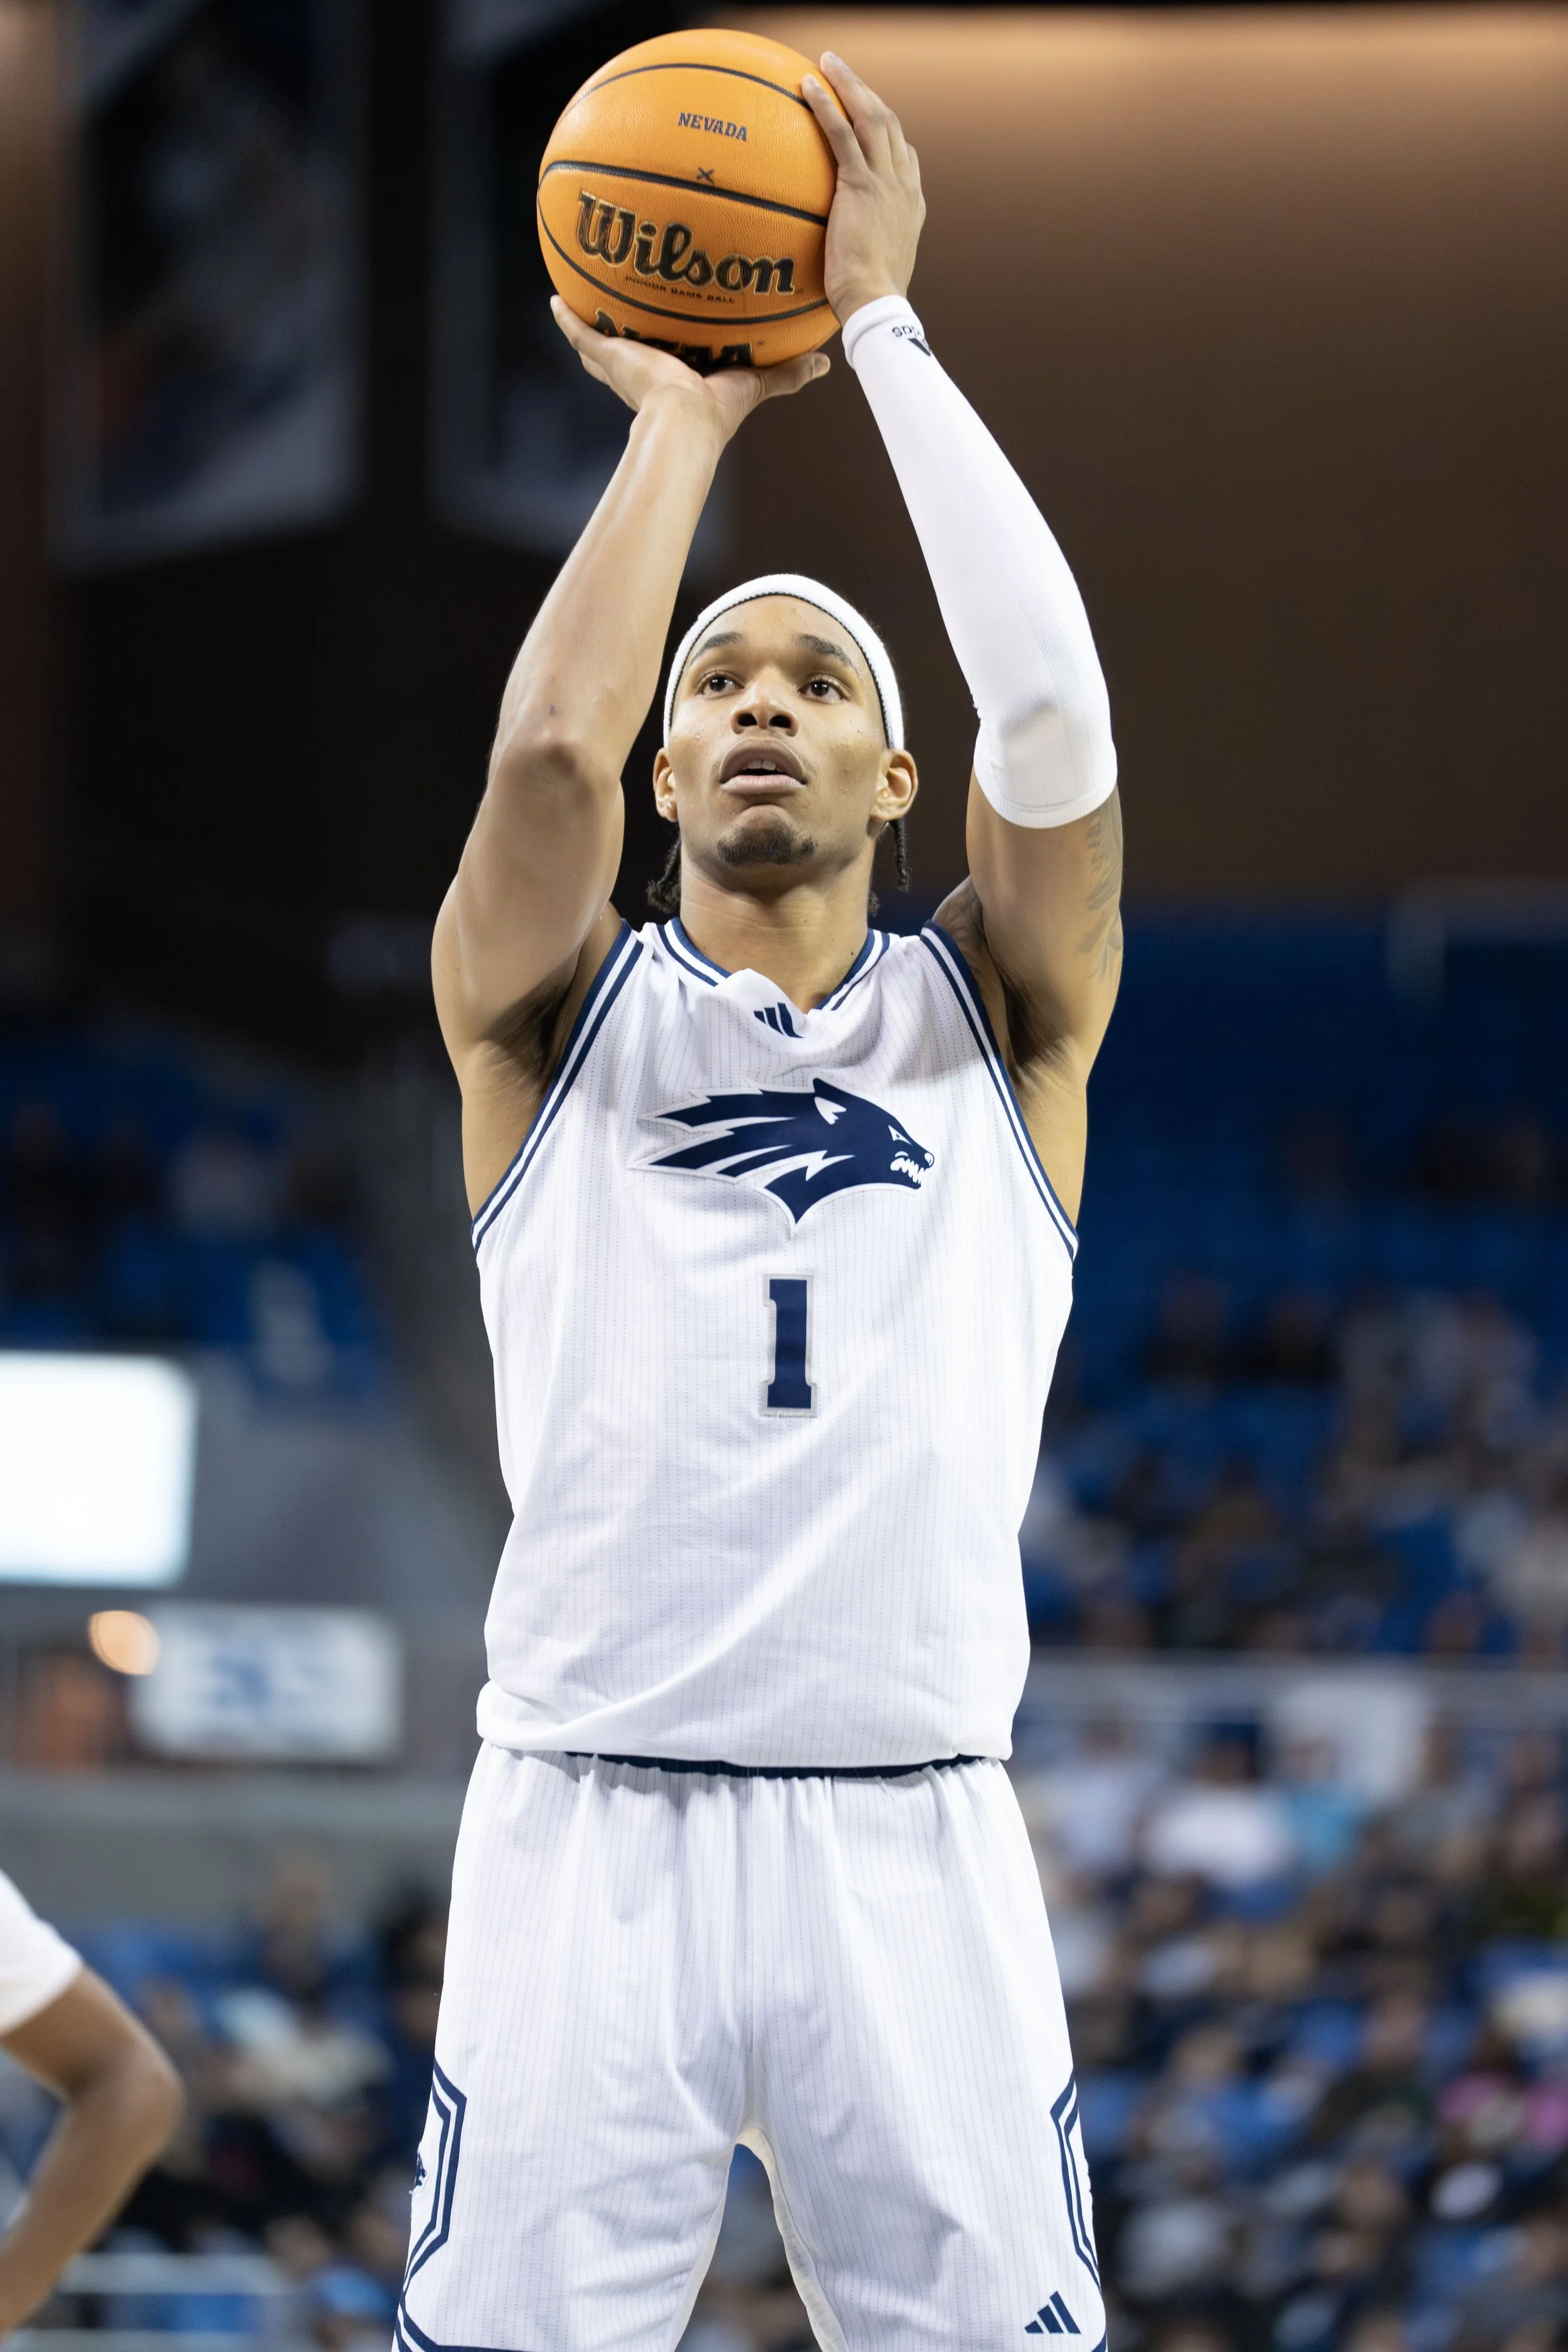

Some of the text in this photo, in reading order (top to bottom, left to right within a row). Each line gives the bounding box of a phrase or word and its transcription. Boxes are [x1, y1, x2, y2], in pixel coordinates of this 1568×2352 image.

[678, 112, 748, 142] NEVADA
[577, 190, 795, 296] Wilson
[625, 275, 735, 304] INDOOR GAME BALL
[764, 1277, 815, 1412] 1
